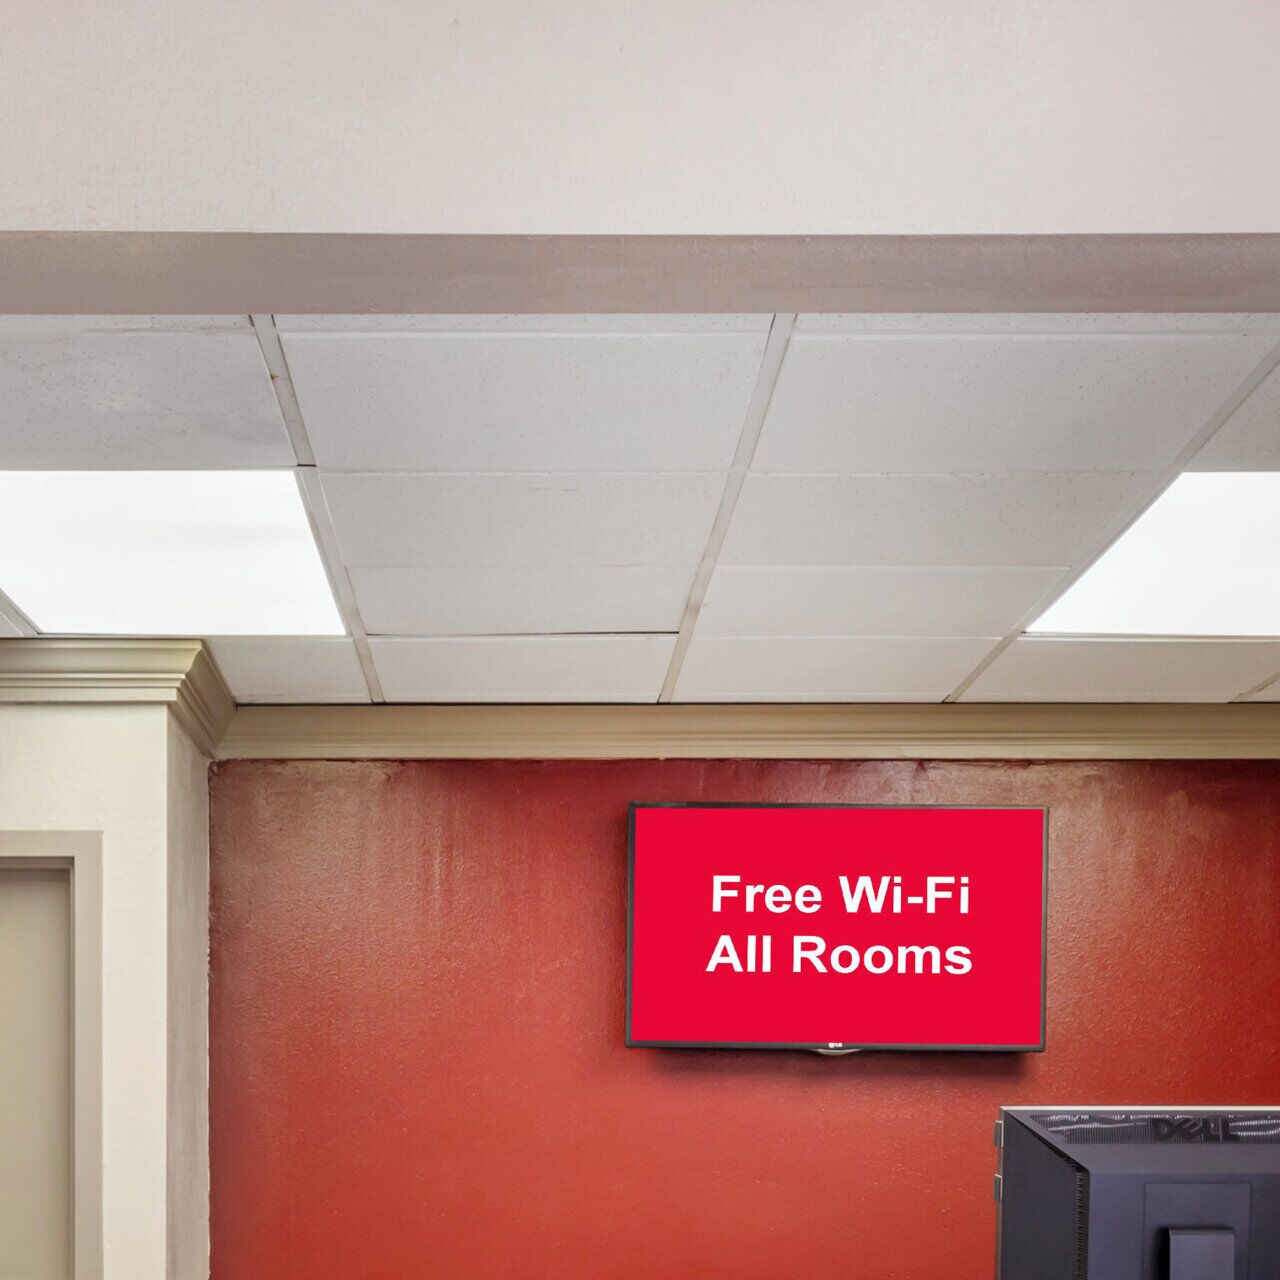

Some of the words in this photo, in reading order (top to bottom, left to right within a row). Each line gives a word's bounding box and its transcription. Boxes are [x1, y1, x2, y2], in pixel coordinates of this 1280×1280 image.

[711, 874, 823, 914] Free
[838, 875, 971, 914] Wi-Fi
[705, 934, 772, 973] All
[792, 935, 973, 975] Rooms
[1153, 1117, 1240, 1142] DELL
